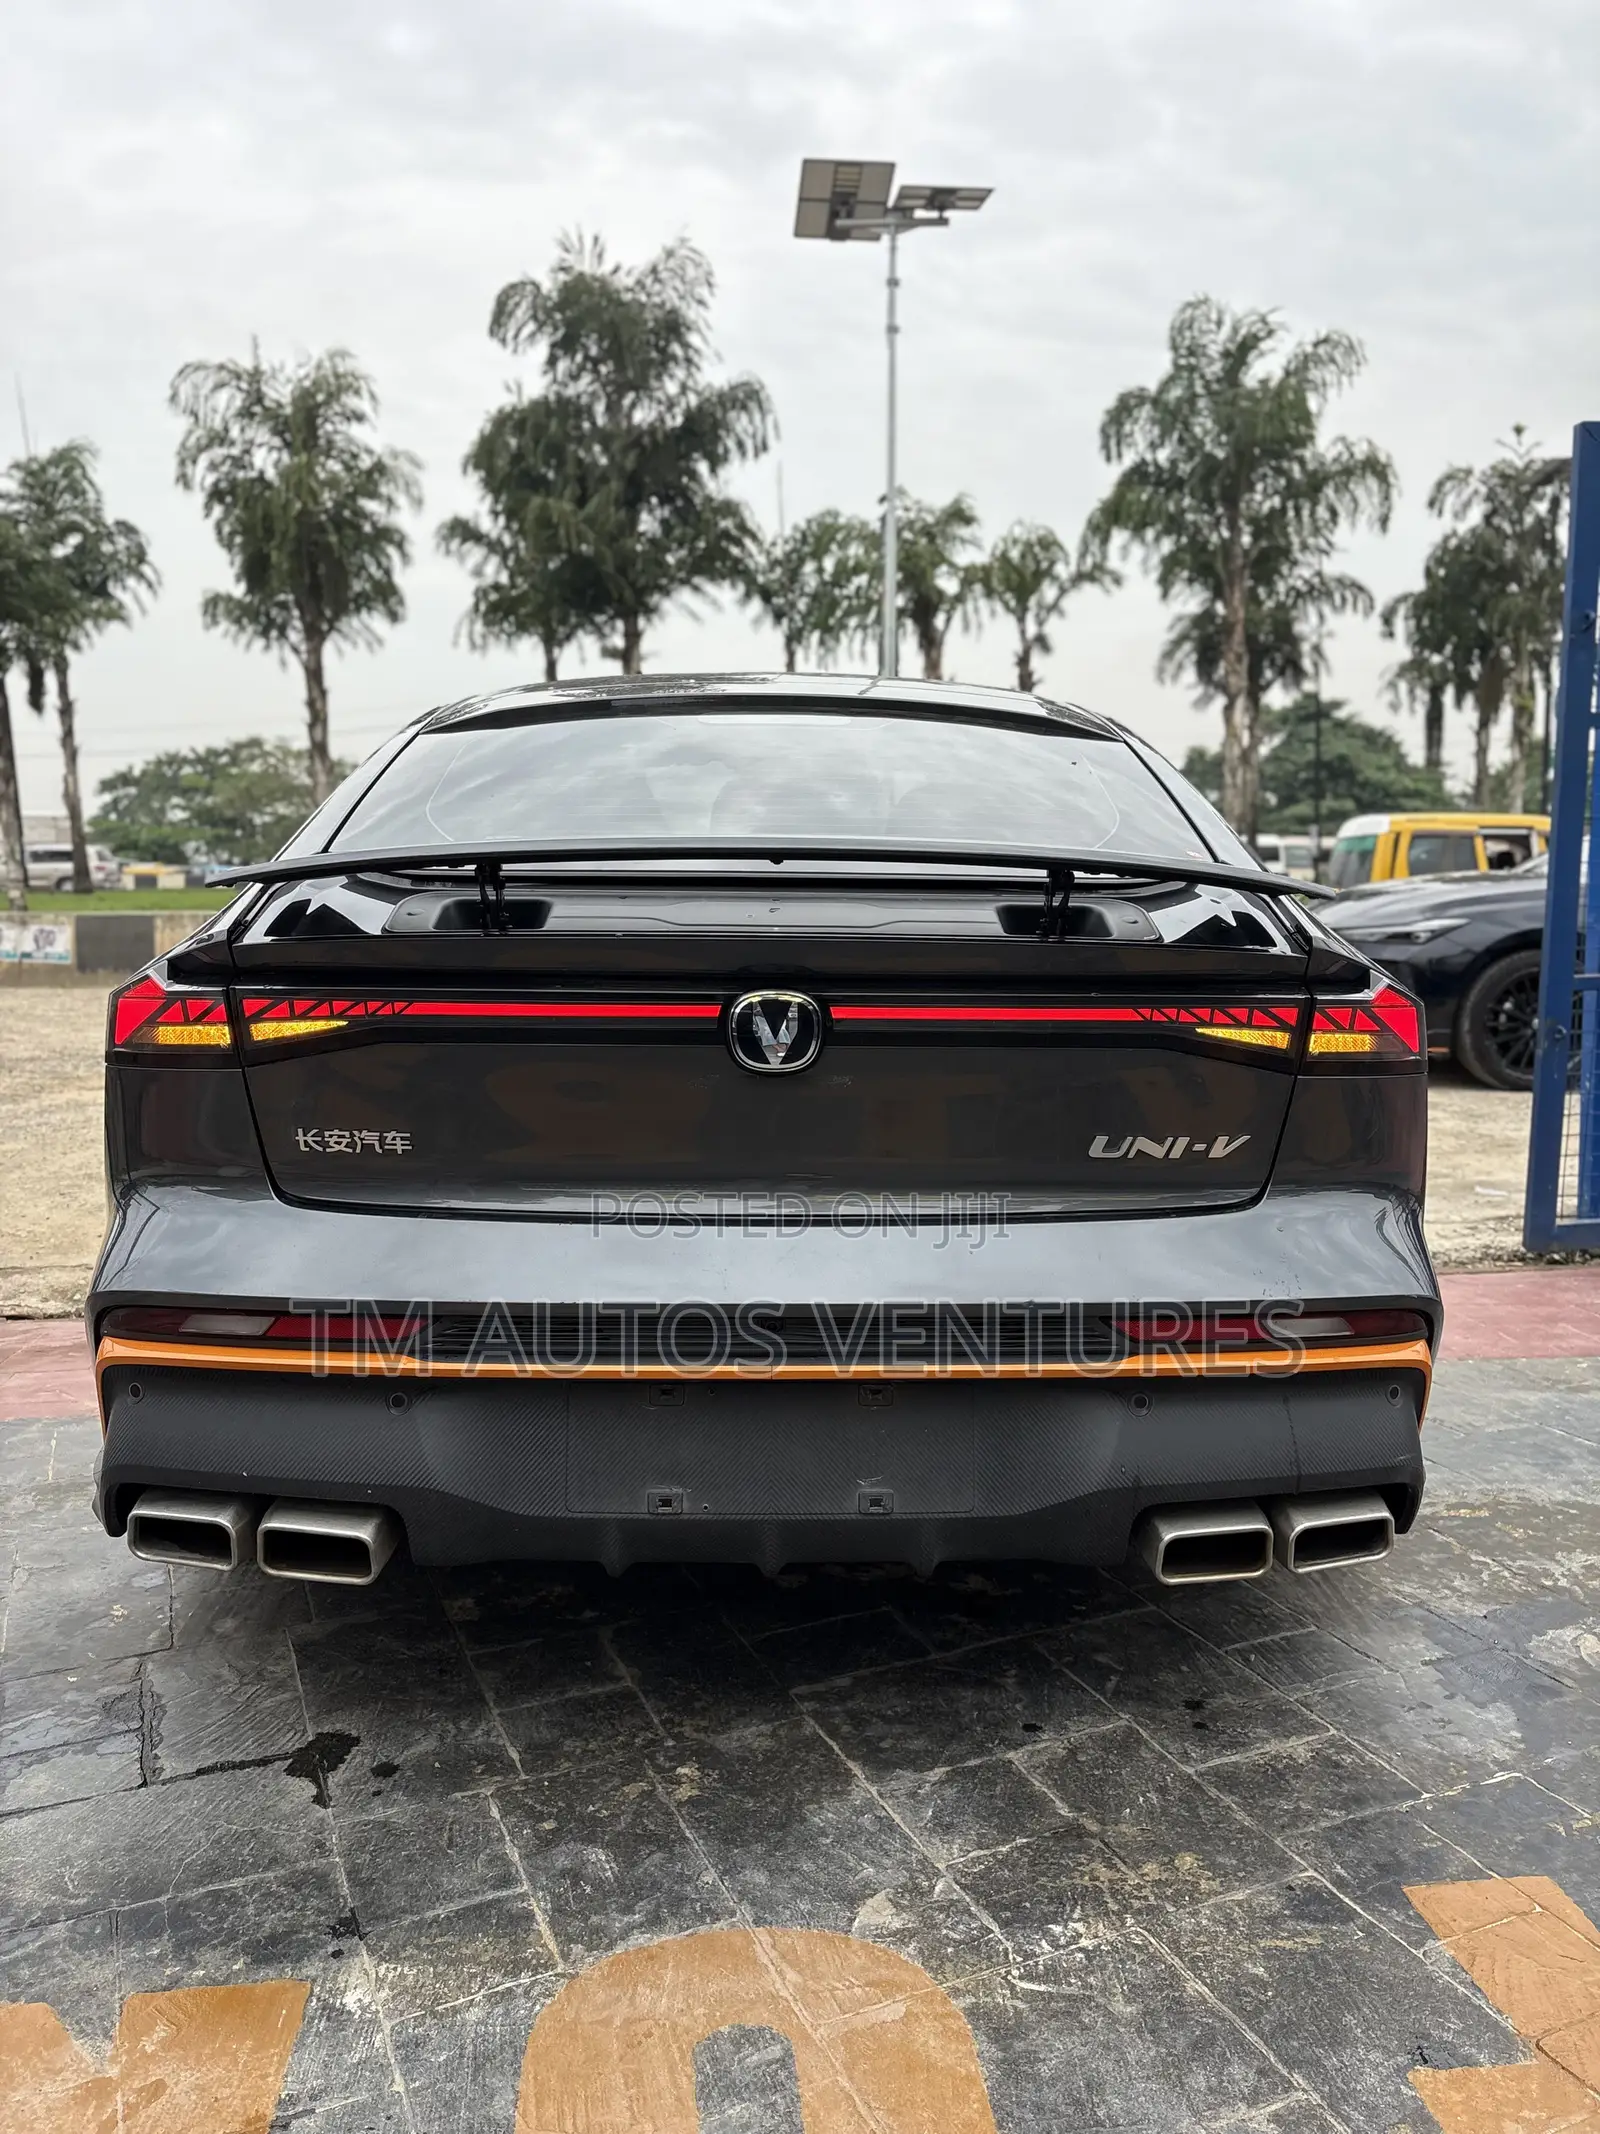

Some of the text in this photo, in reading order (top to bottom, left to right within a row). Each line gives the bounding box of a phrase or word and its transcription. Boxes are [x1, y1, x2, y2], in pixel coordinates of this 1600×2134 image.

[295, 1128, 412, 1154] 长安汽车
[1088, 1135, 1251, 1159] UNI-V
